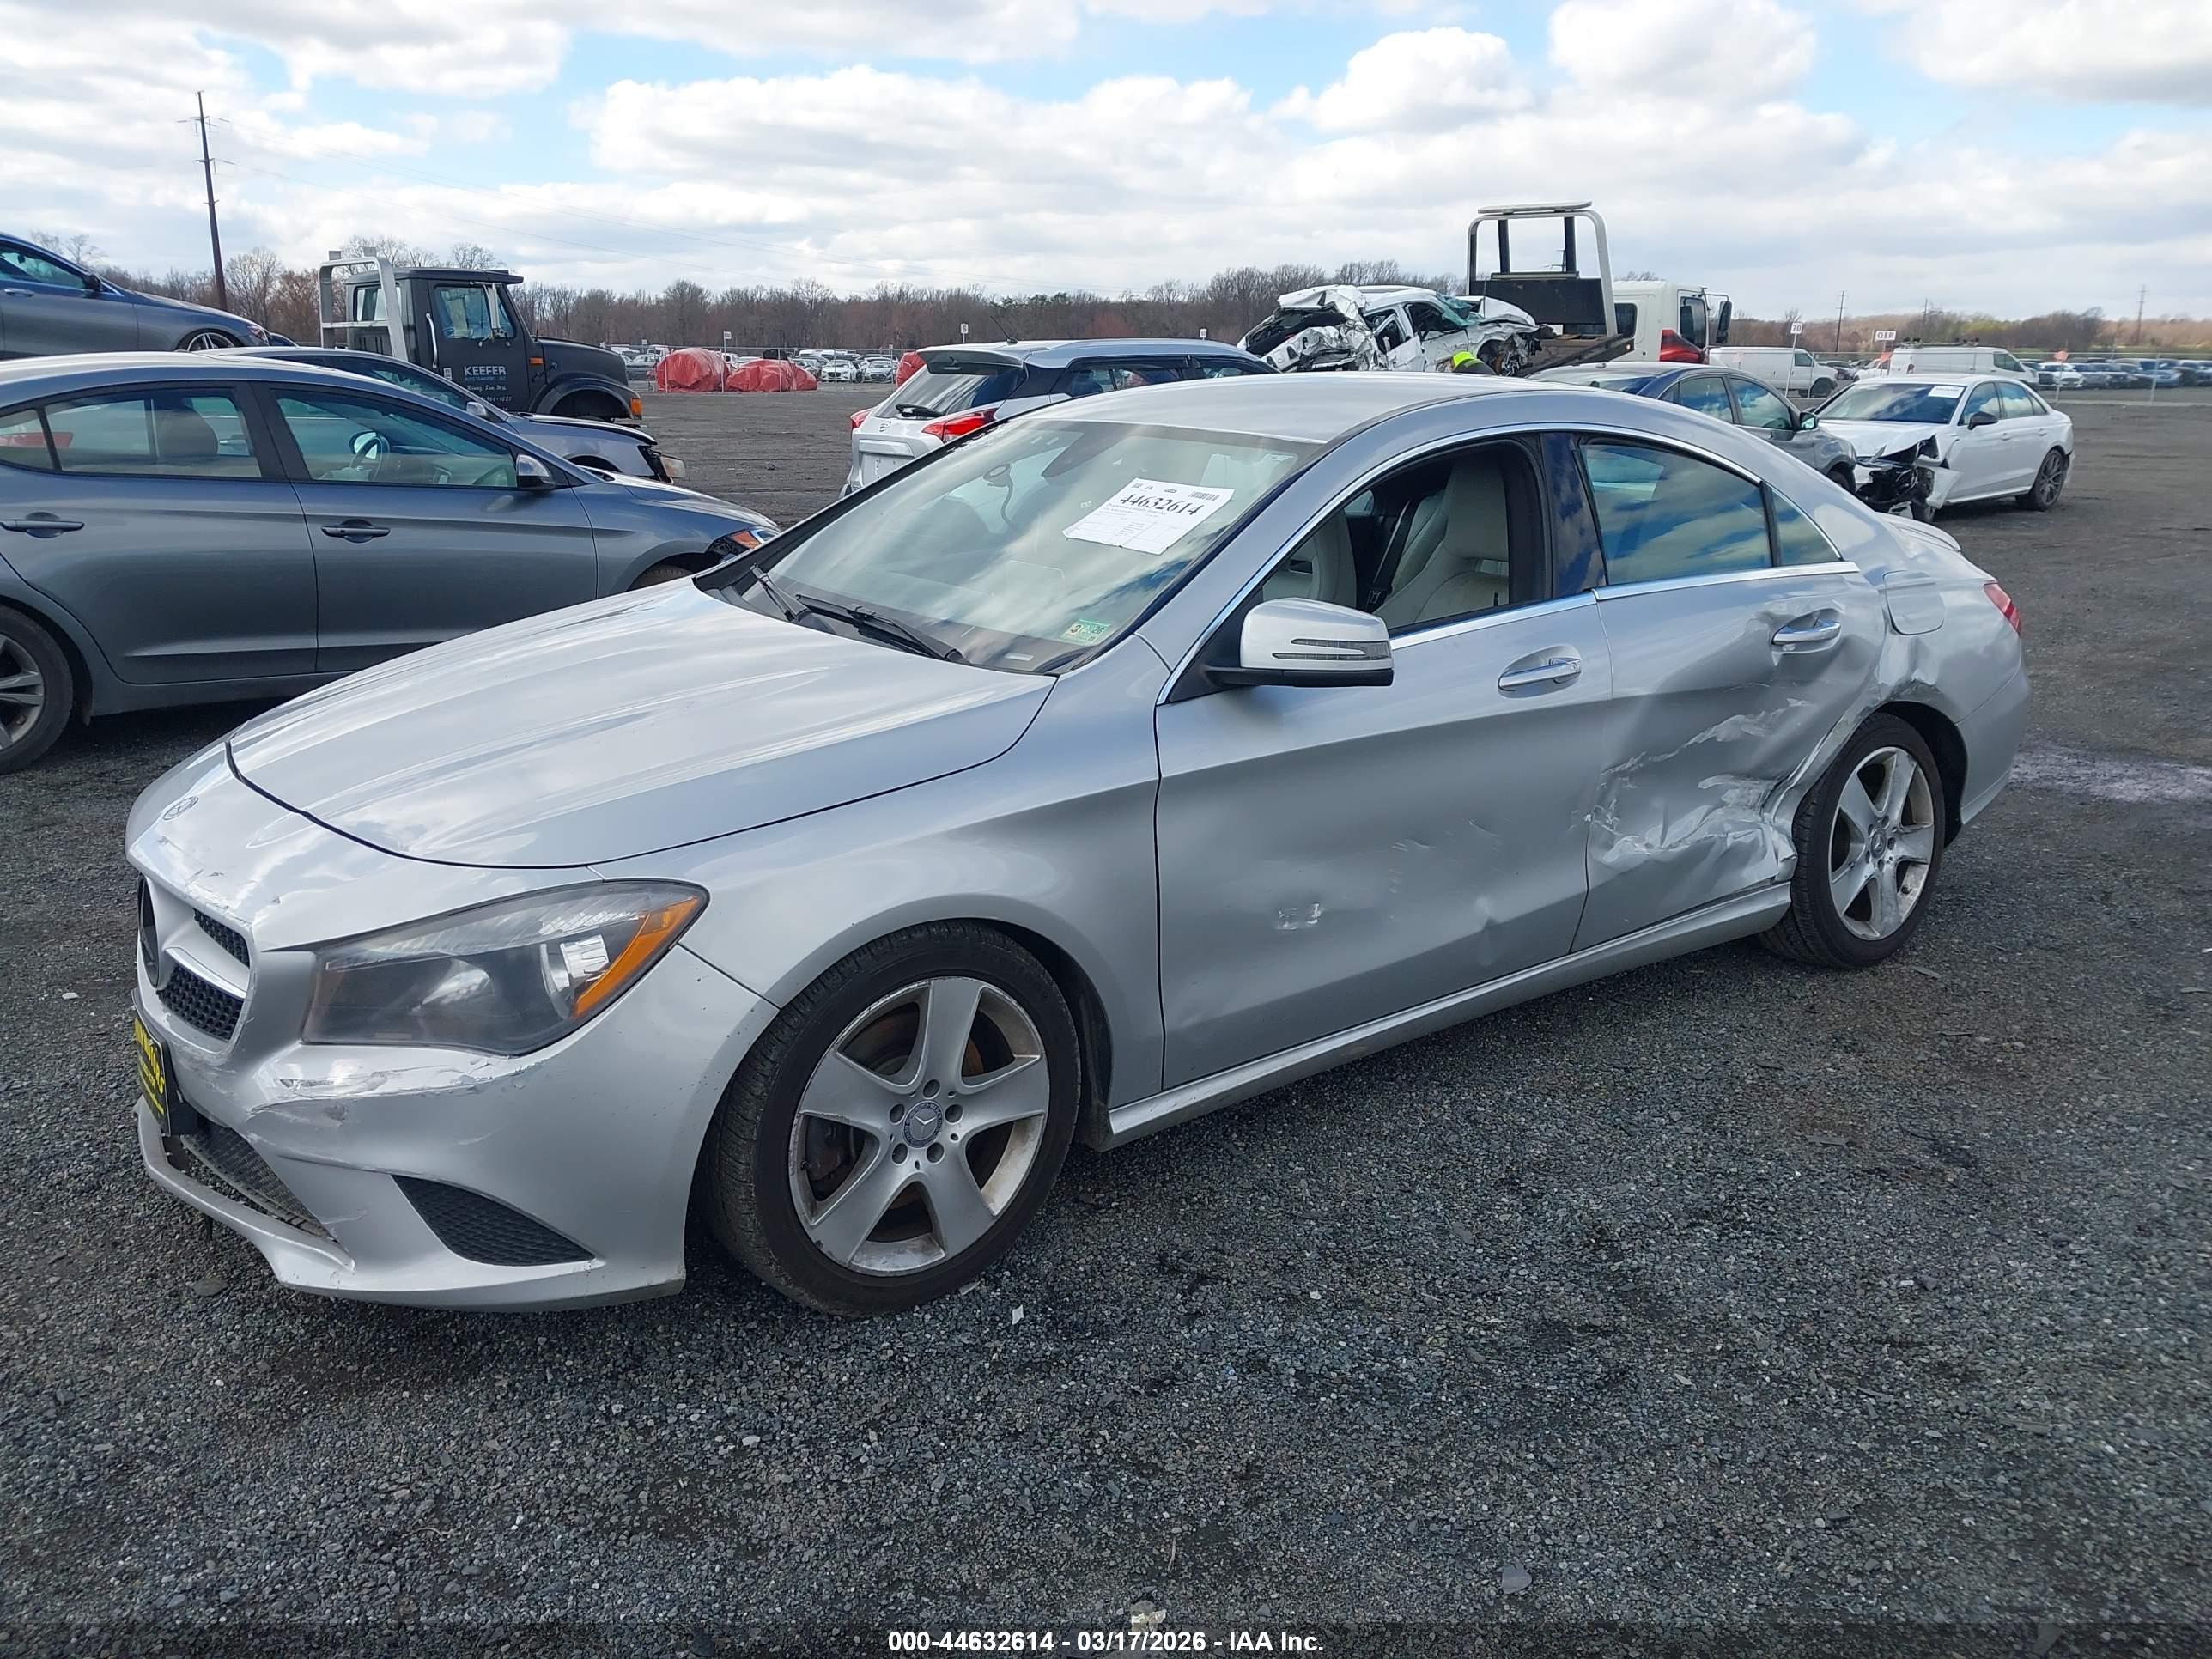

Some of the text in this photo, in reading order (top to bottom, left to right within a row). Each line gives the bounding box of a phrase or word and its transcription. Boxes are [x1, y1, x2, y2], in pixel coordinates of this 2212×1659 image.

[1792, 324, 1802, 332] 70
[464, 366, 507, 375] KEEFER
[1120, 493, 1204, 515] 44632614
